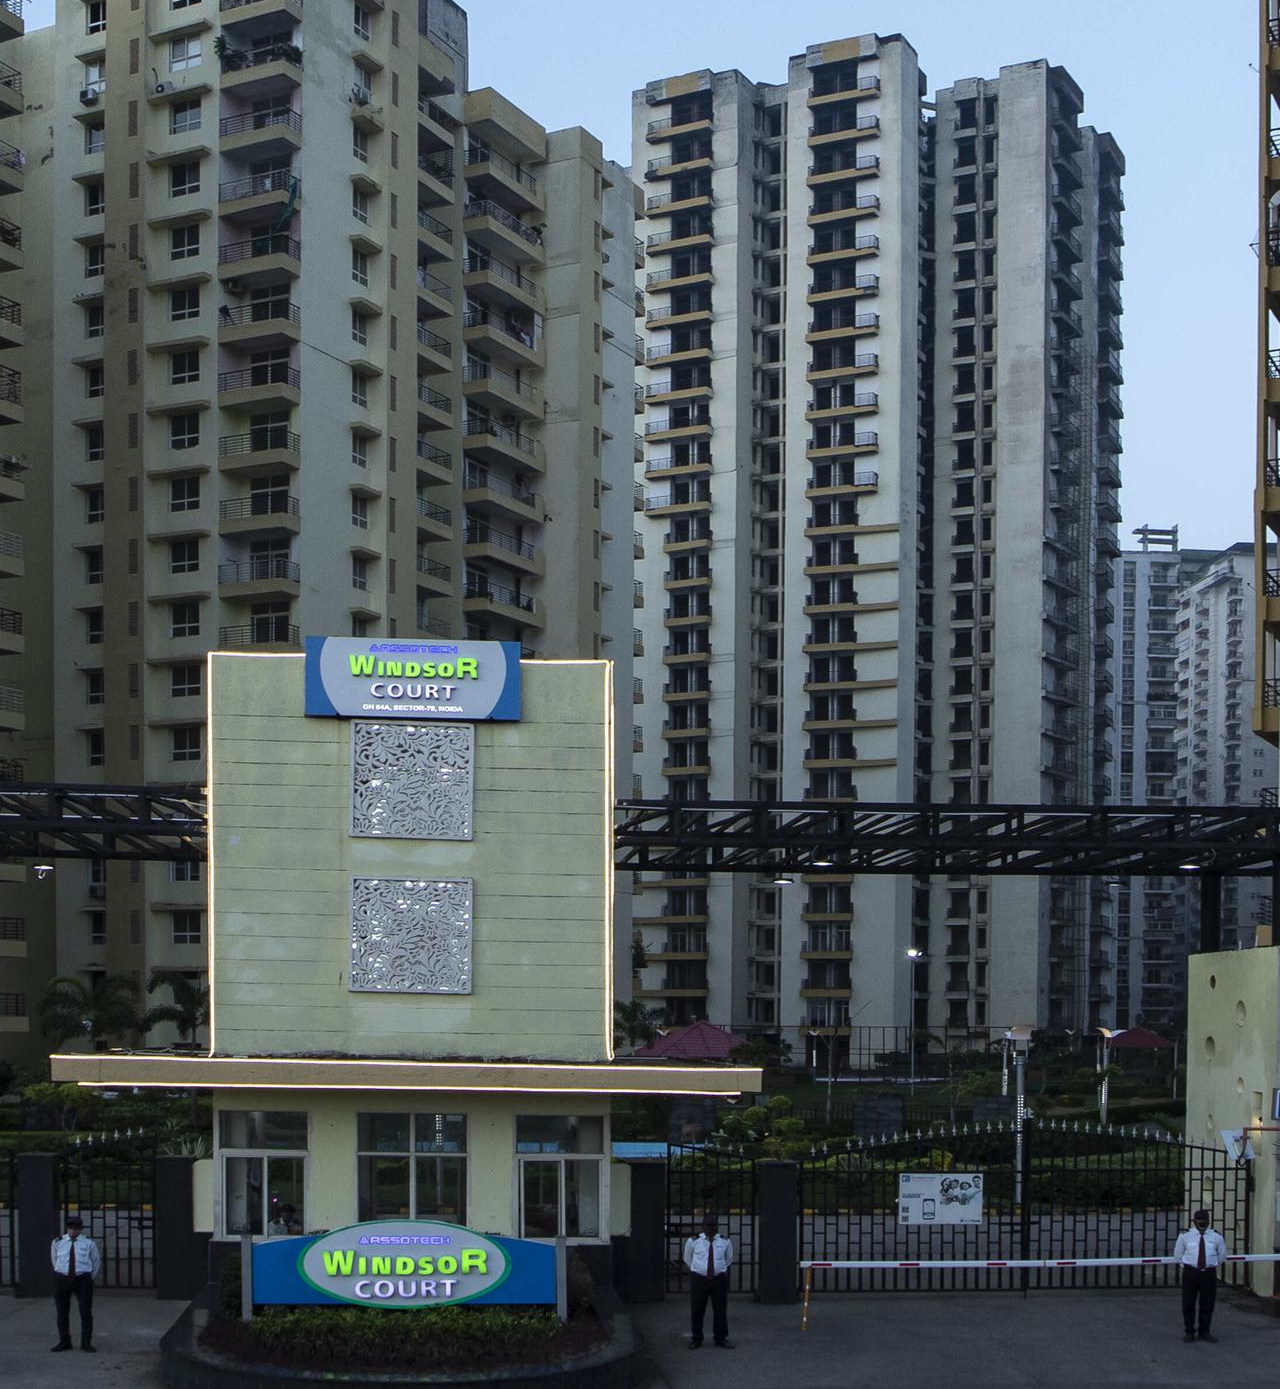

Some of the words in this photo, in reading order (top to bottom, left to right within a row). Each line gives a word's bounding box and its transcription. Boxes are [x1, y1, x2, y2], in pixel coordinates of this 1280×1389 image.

[348, 654, 479, 680] WINDSOR
[370, 682, 457, 700] COURT
[370, 1235, 451, 1245] ASSOTECH
[322, 1248, 489, 1276] WINDSOR
[354, 1278, 458, 1299] COURT
